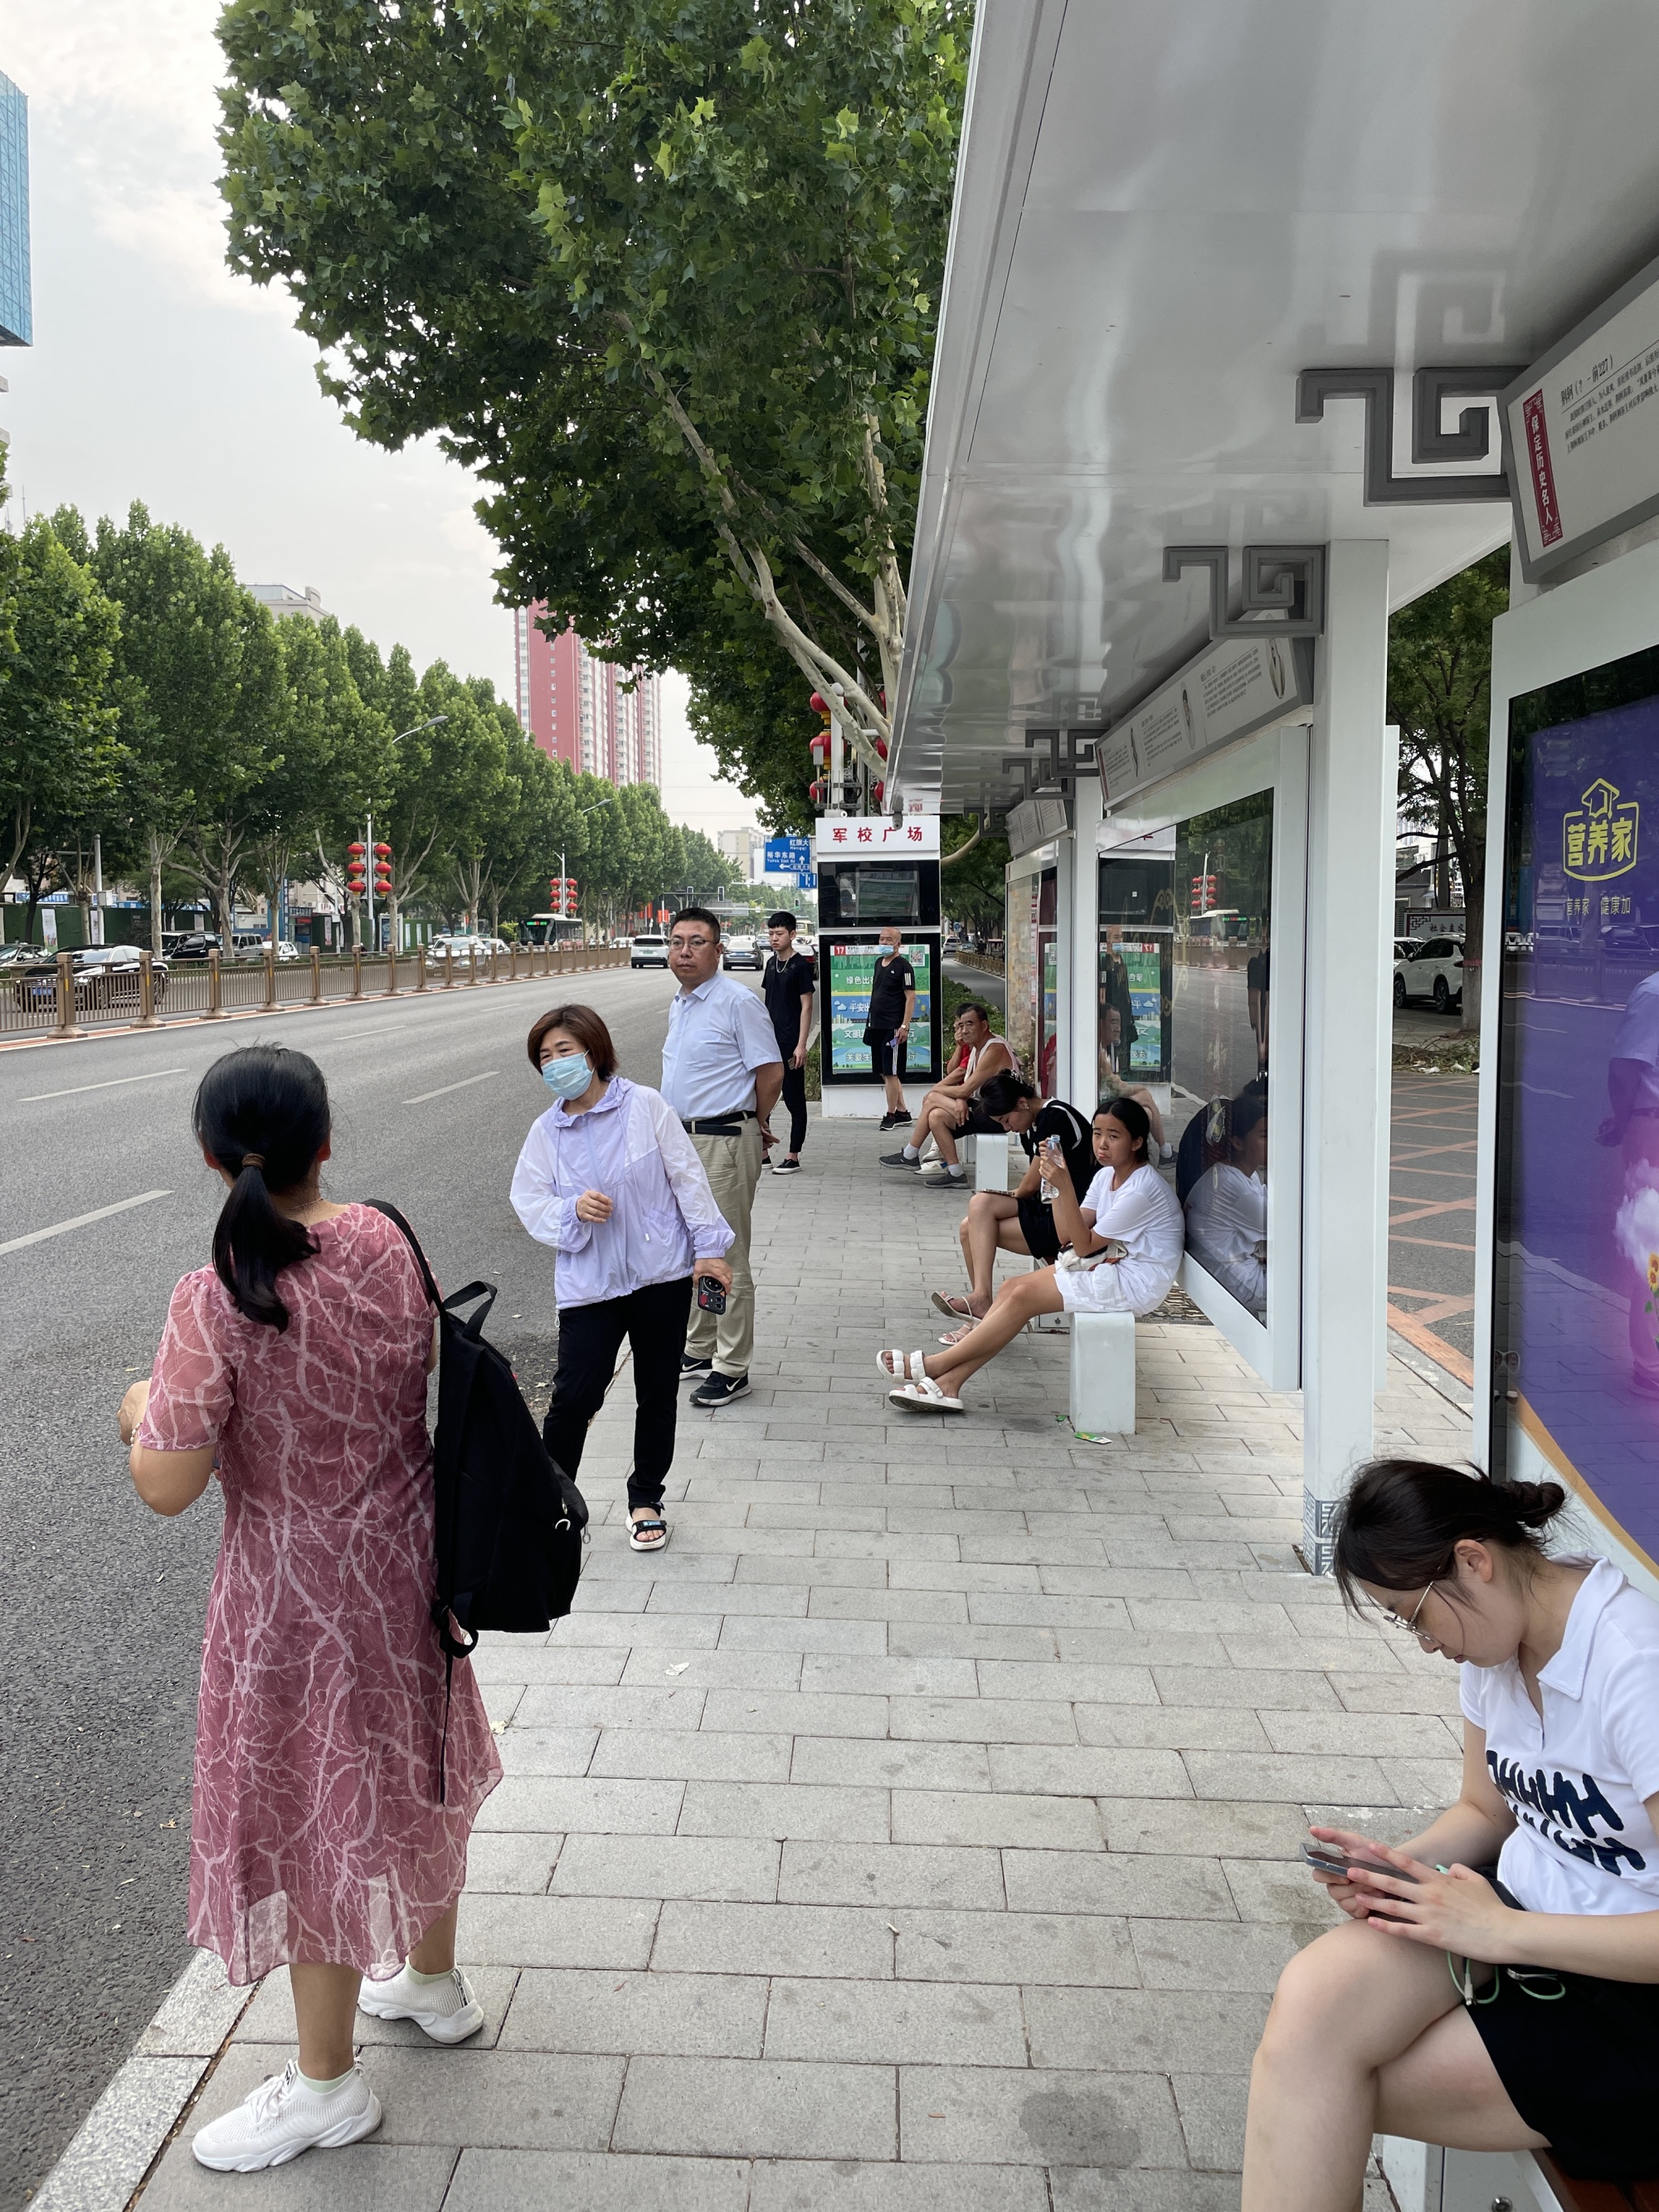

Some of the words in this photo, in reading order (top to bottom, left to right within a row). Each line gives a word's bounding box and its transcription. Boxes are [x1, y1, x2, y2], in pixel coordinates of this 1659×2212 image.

[1531, 415, 1553, 526] 保定历史名人
[832, 826, 922, 843] 军校广场
[1568, 817, 1632, 867] 营养家
[766, 851, 795, 859] 裕华东路
[1566, 896, 1590, 916] 营养家
[1600, 895, 1631, 916] 健康加
[1429, 923, 1465, 932] 社会主义
[836, 946, 844, 955] 17
[907, 1052, 916, 1061] 行
